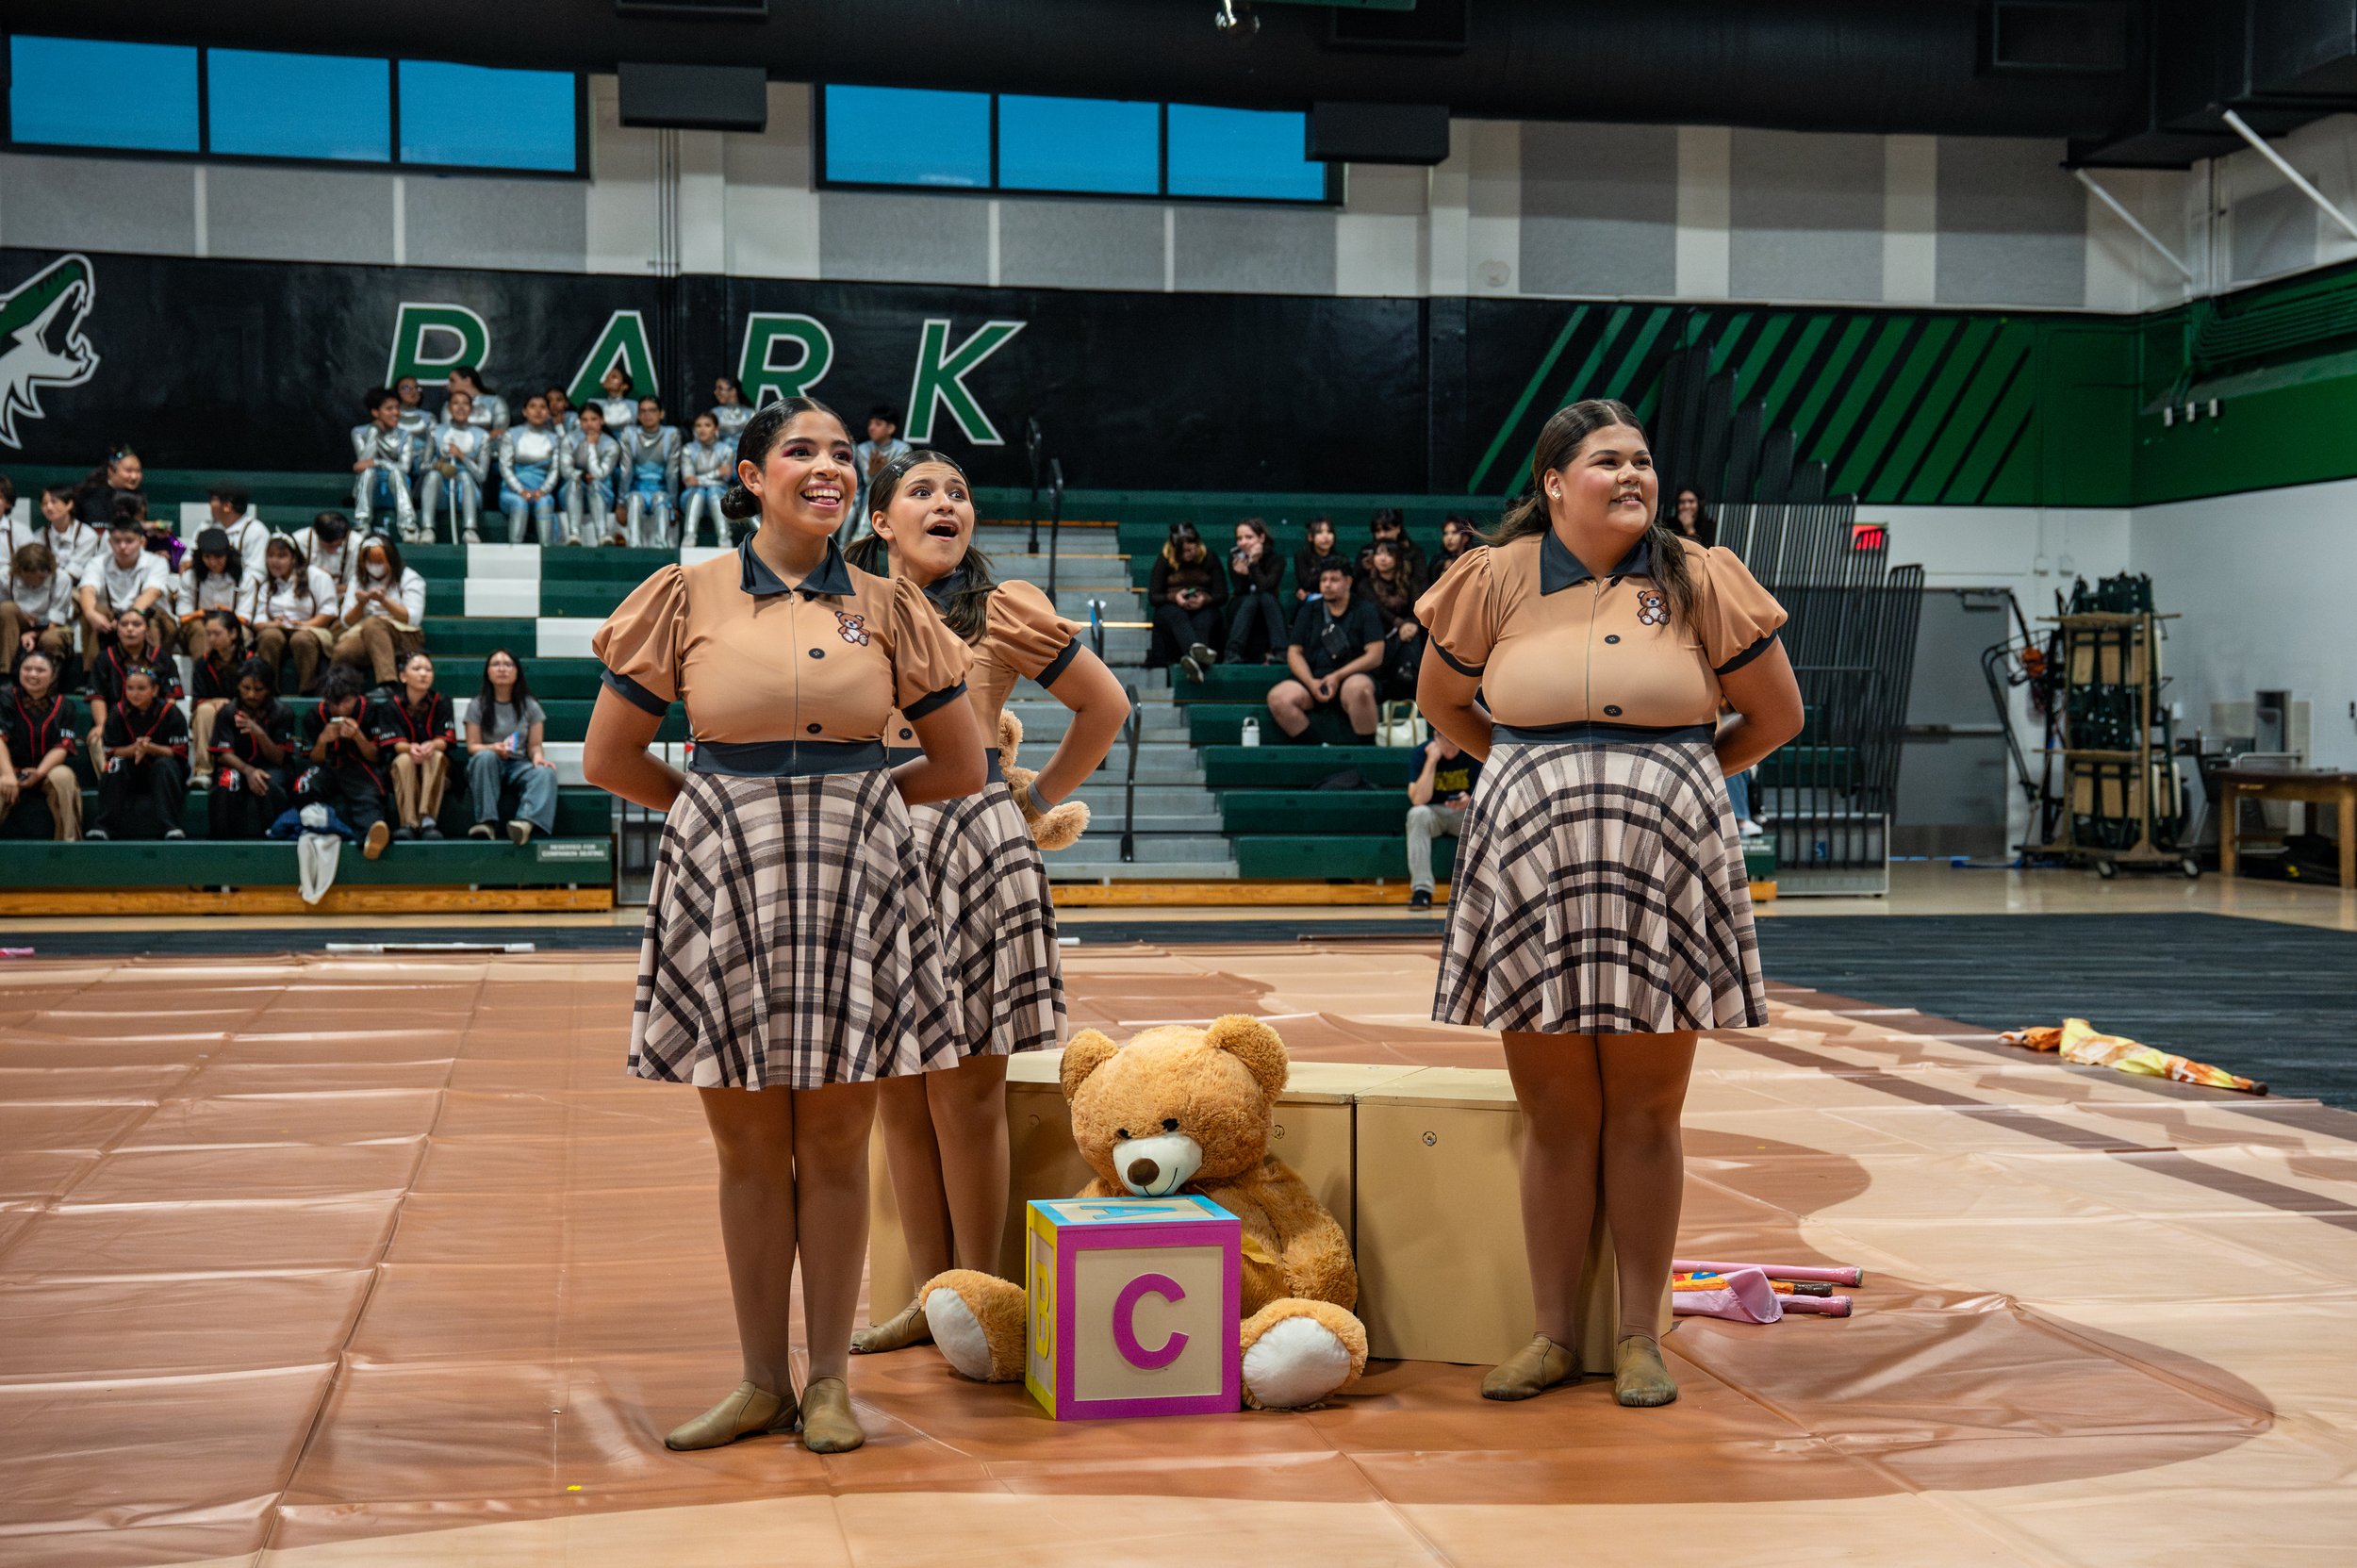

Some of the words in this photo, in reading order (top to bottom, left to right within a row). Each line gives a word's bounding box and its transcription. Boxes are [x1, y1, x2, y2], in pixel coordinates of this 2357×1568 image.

[385, 302, 1028, 447] PARK
[1035, 1259, 1051, 1360] B
[1112, 1272, 1190, 1371] C
